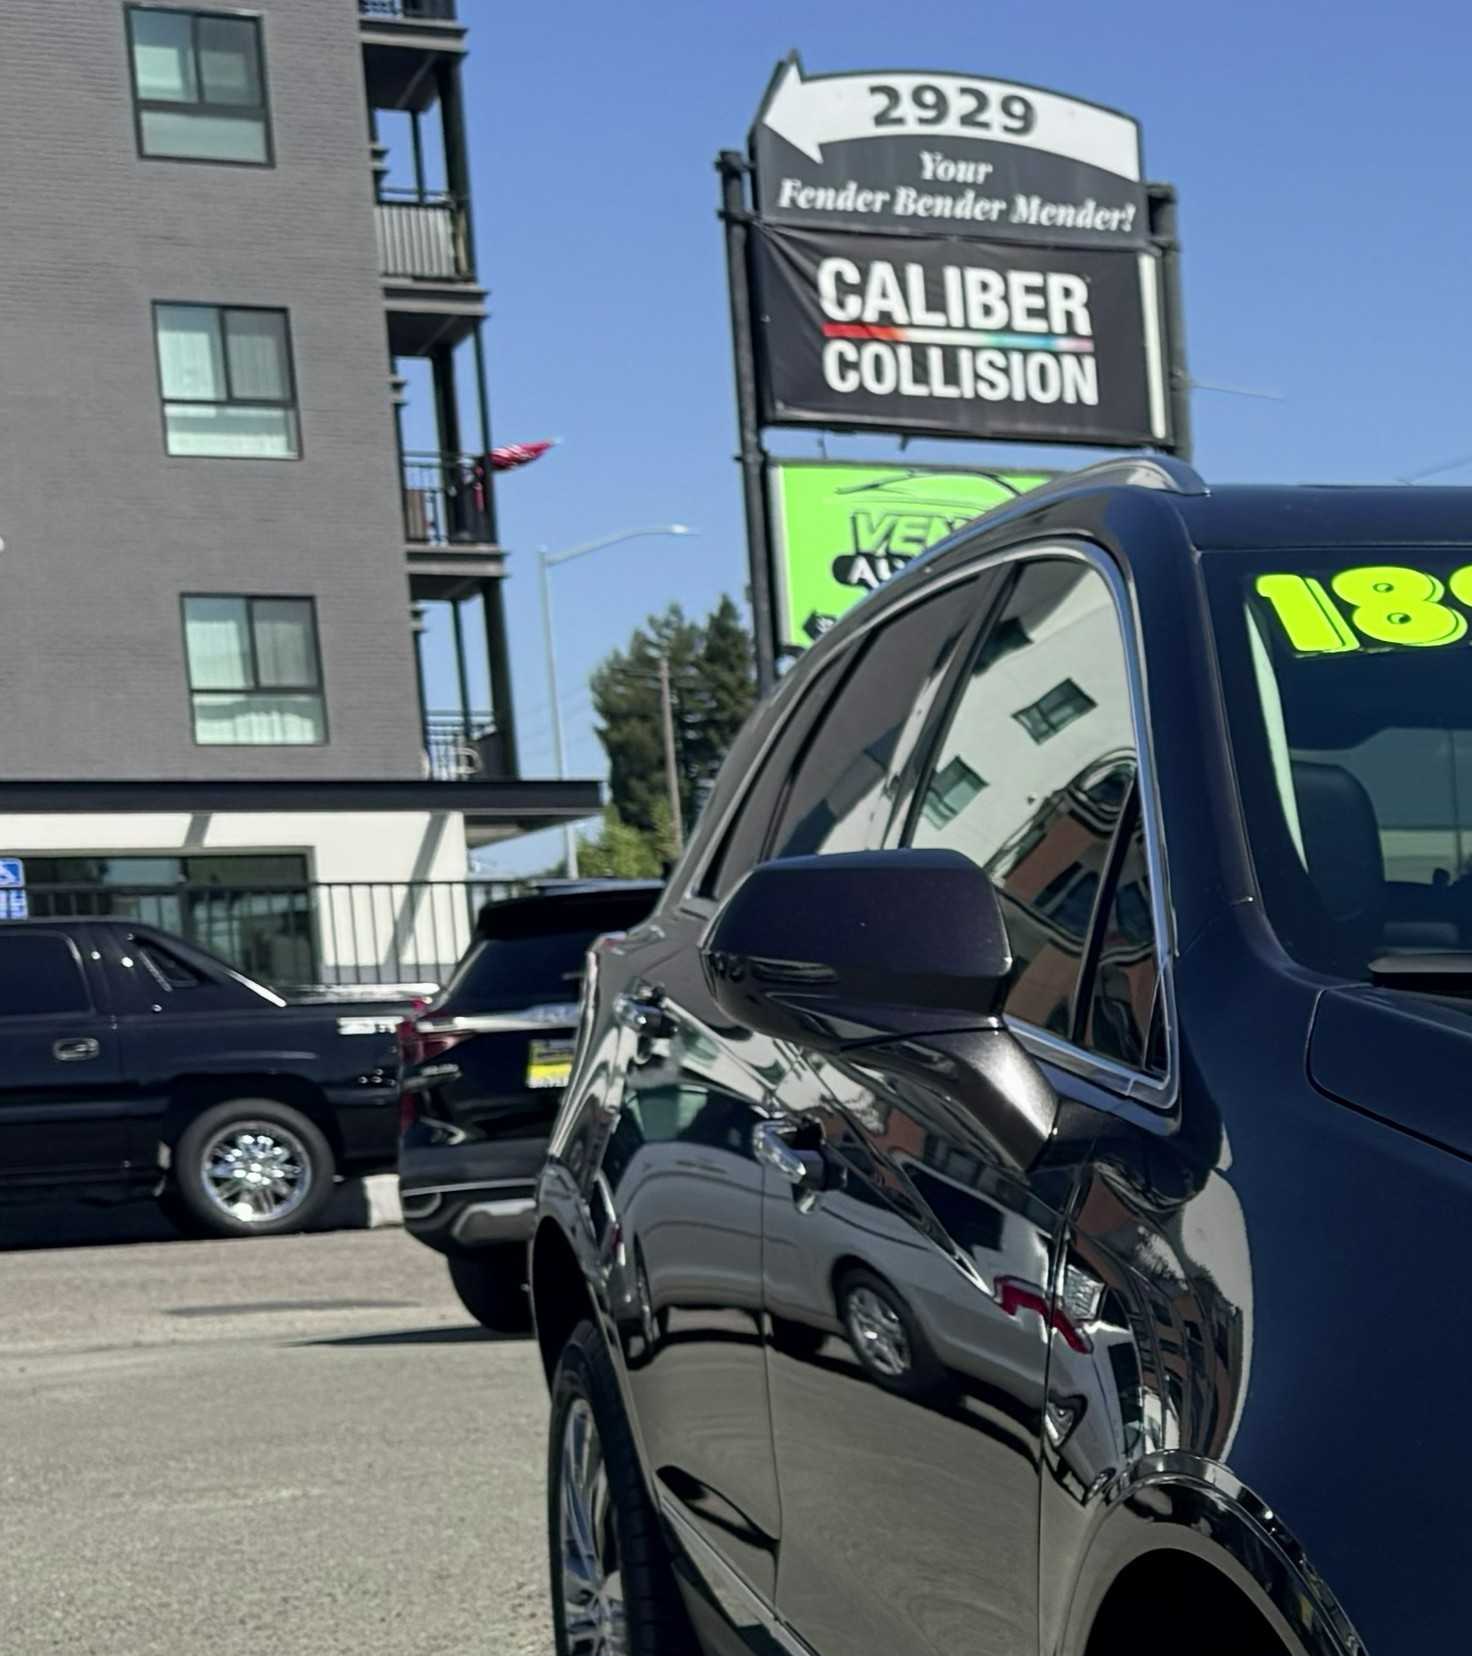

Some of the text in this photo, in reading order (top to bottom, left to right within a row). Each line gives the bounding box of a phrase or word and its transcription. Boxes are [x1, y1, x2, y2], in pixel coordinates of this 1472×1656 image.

[869, 83, 1037, 136] 2929
[918, 150, 993, 184] Your
[778, 178, 1136, 232] Fender Bender Mender!
[816, 256, 1092, 336] CALIBER
[822, 340, 1099, 406] COLLISION
